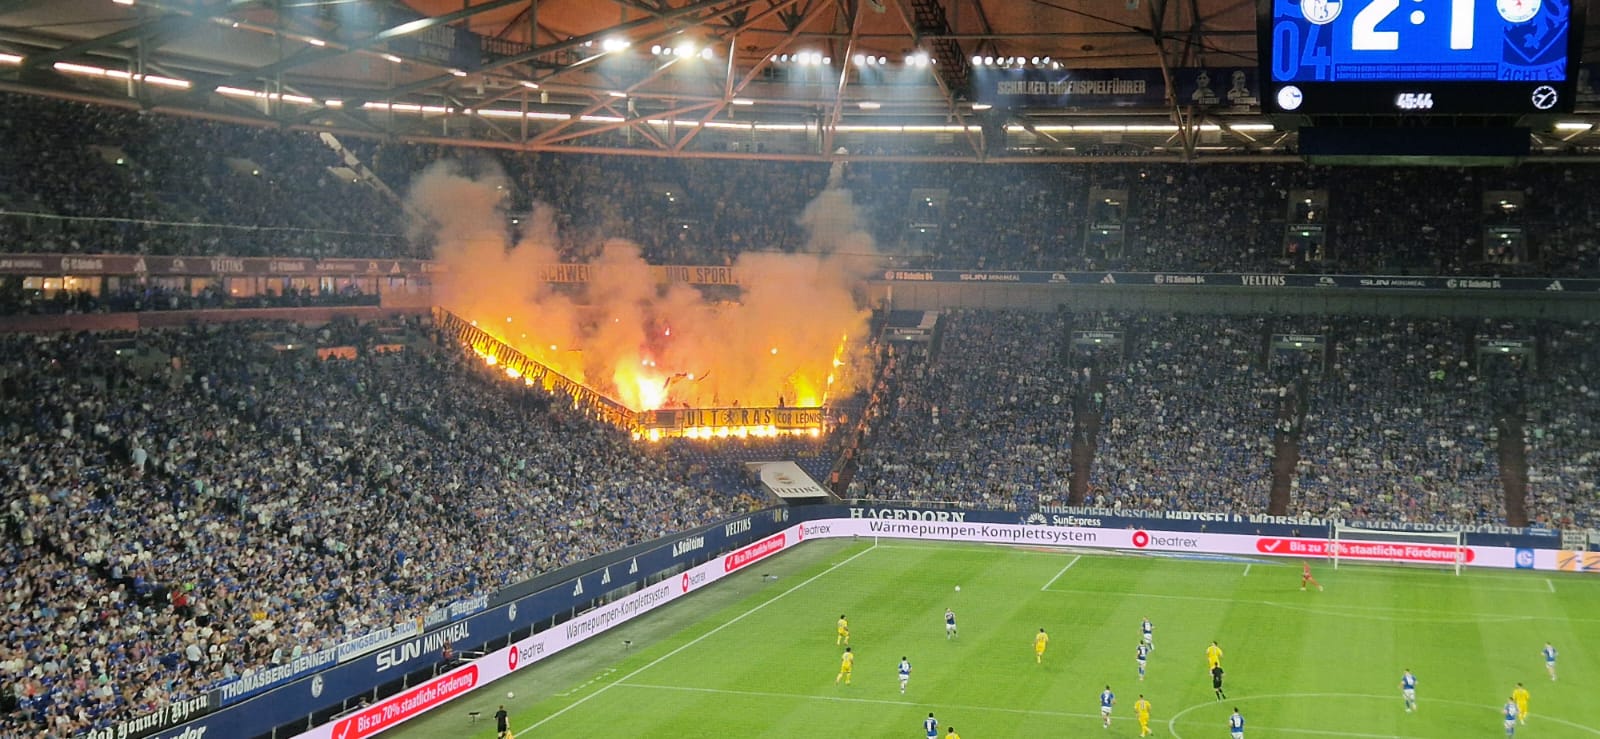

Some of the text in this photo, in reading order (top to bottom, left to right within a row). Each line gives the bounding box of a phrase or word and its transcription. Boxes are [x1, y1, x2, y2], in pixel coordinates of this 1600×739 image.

[997, 78, 1146, 96] SCHALKER EHRENSPIELFÜHRER
[210, 257, 244, 272] VELTINS
[1241, 275, 1286, 287] VELTINS
[1360, 279, 1389, 287] SUN
[778, 412, 792, 425] COR
[772, 486, 820, 494] VELTINS
[849, 508, 966, 523] HAGEDORN
[1053, 515, 1101, 527] SunExpress
[725, 517, 752, 537] VELTINS
[869, 521, 1097, 544] Wärmepumpen-Komplettsystem
[1151, 534, 1198, 548] heatrex
[1289, 540, 1465, 562] Bis zu 70% staatliche Förderung
[566, 586, 670, 640] Wärmepumpen-Komplettsystem
[376, 621, 470, 672] SUN MINIMEAL
[519, 641, 545, 661] heatrex
[358, 672, 473, 733] Bis zu 70% staatliche Förderung
